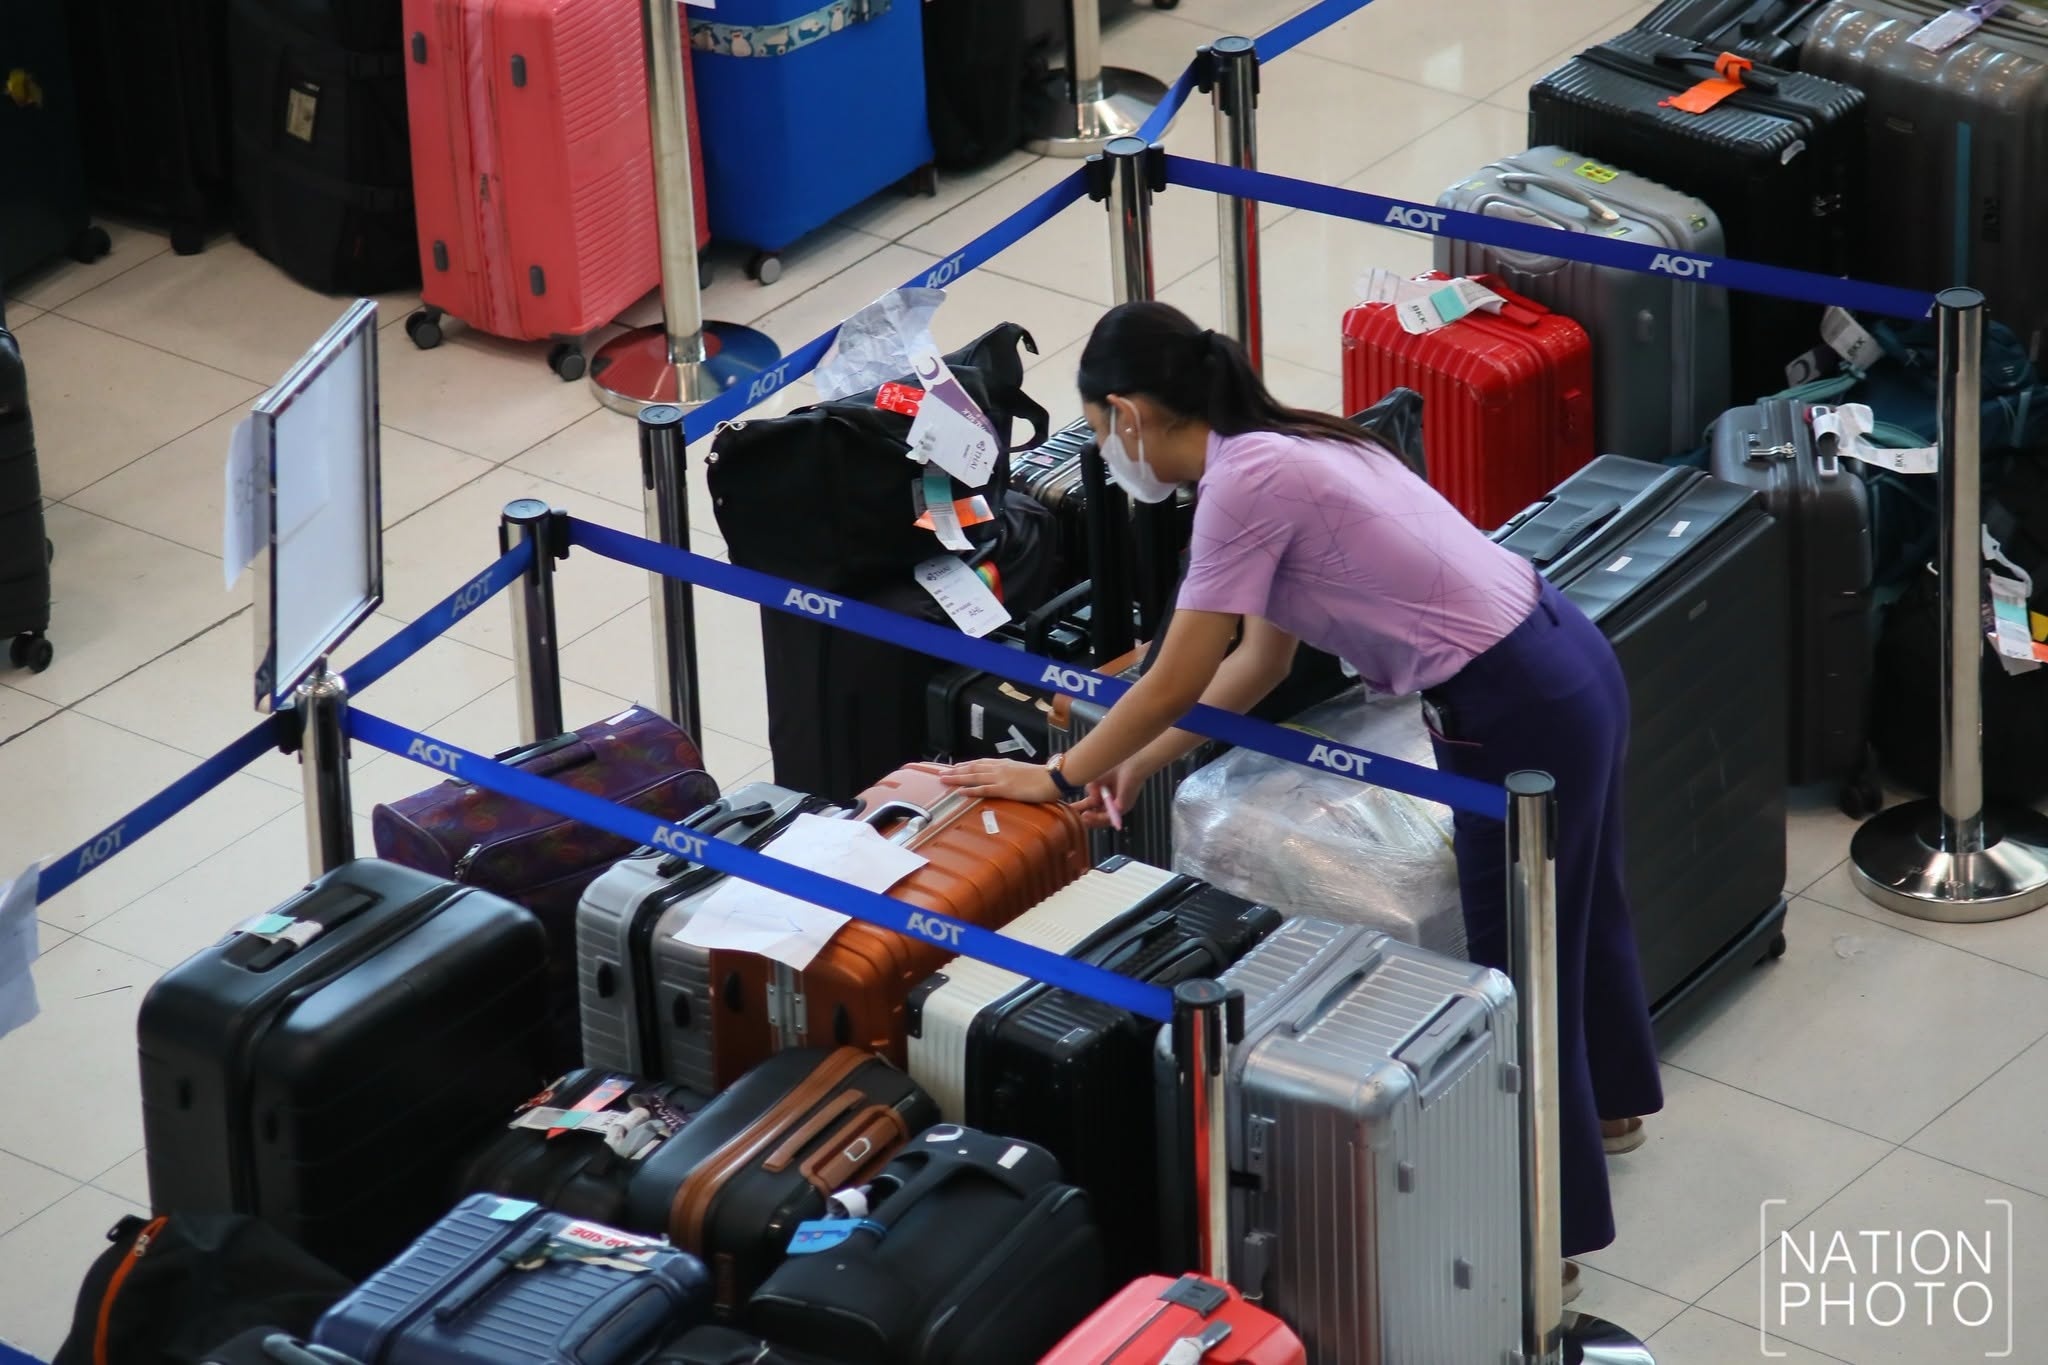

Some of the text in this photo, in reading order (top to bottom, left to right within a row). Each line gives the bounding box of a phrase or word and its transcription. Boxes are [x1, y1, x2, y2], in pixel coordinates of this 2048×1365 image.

[1385, 206, 1447, 232] AOT
[925, 252, 966, 289] AOT
[1649, 253, 1712, 280] AOT
[747, 369, 789, 405] AOT
[451, 572, 494, 618] AOT
[784, 588, 843, 618] AOT
[1040, 665, 1103, 696] AOT
[407, 739, 464, 771] AOT
[1308, 744, 1373, 777] AOT
[77, 823, 127, 873] AOT
[652, 825, 708, 859] AOT
[906, 912, 966, 946] AOT
[569, 1227, 604, 1243] SIDE
